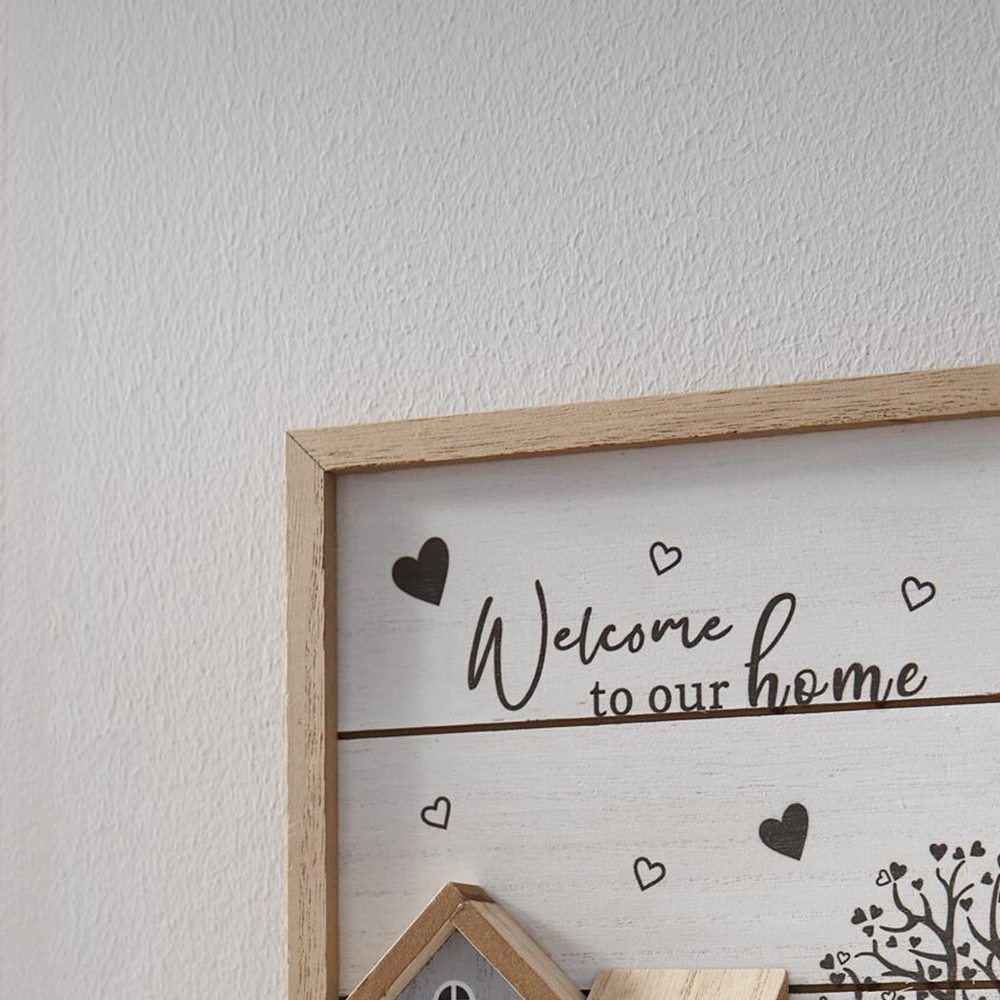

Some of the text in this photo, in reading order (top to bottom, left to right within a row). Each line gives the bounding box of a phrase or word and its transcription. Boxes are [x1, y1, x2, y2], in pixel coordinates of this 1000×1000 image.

[468, 579, 733, 711] Welcome
[590, 592, 927, 716] to our home
